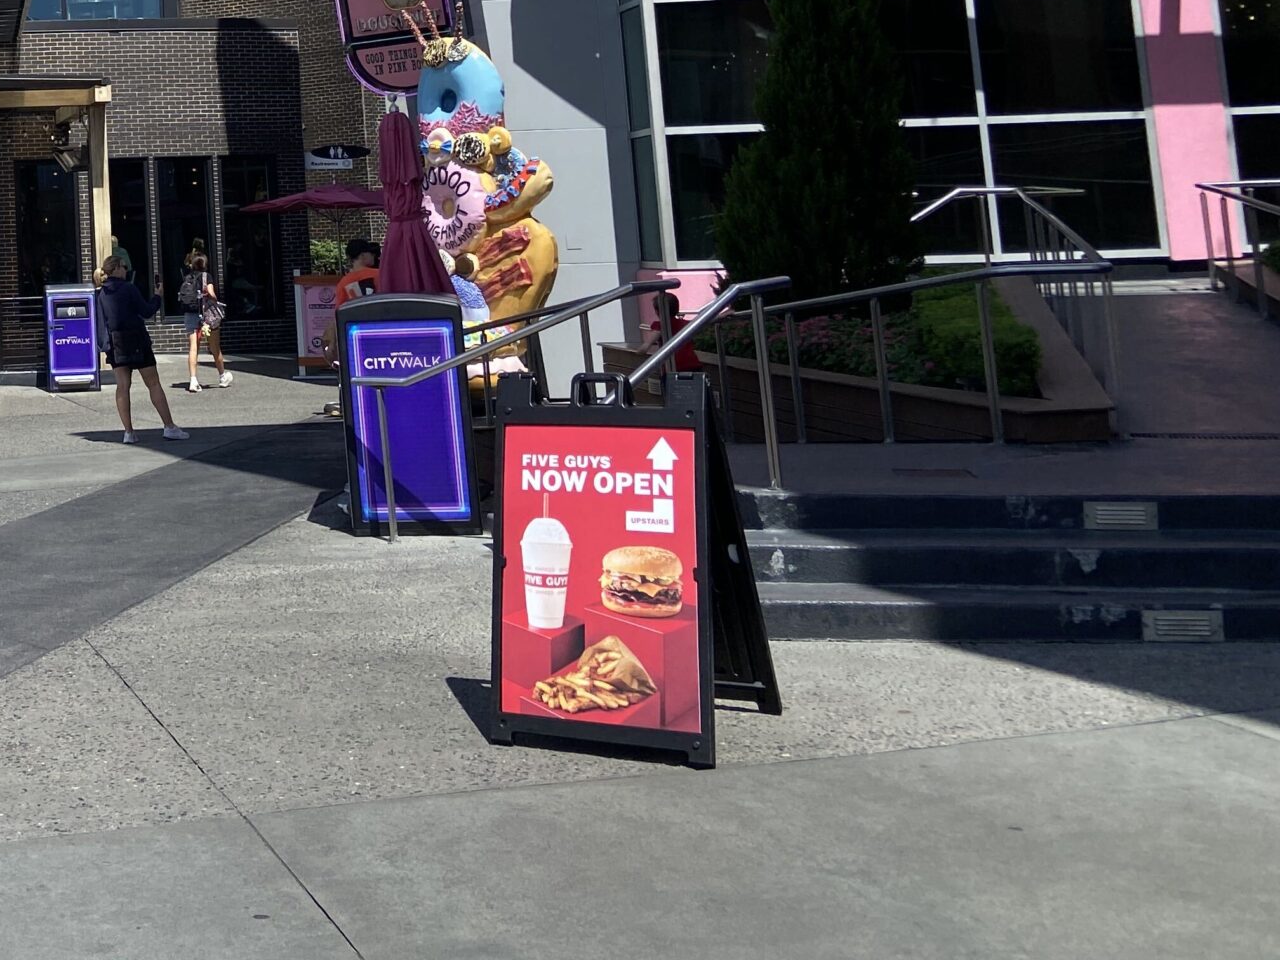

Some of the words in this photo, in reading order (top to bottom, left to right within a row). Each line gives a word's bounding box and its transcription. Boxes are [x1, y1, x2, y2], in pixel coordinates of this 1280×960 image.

[365, 51, 385, 65] GOOD
[388, 47, 418, 62] THINGS
[374, 64, 384, 76] IN
[387, 62, 408, 74] PINK
[422, 166, 471, 197] OODOO
[444, 222, 476, 251] ORLANDO
[55, 337, 90, 345] CITYWALK
[363, 355, 441, 370] CITYWALK
[521, 454, 559, 468] FIVE
[564, 455, 612, 469] GUYS
[521, 469, 588, 492] NOW
[593, 472, 673, 496] OPEN
[630, 517, 670, 526] UPSTAIRS
